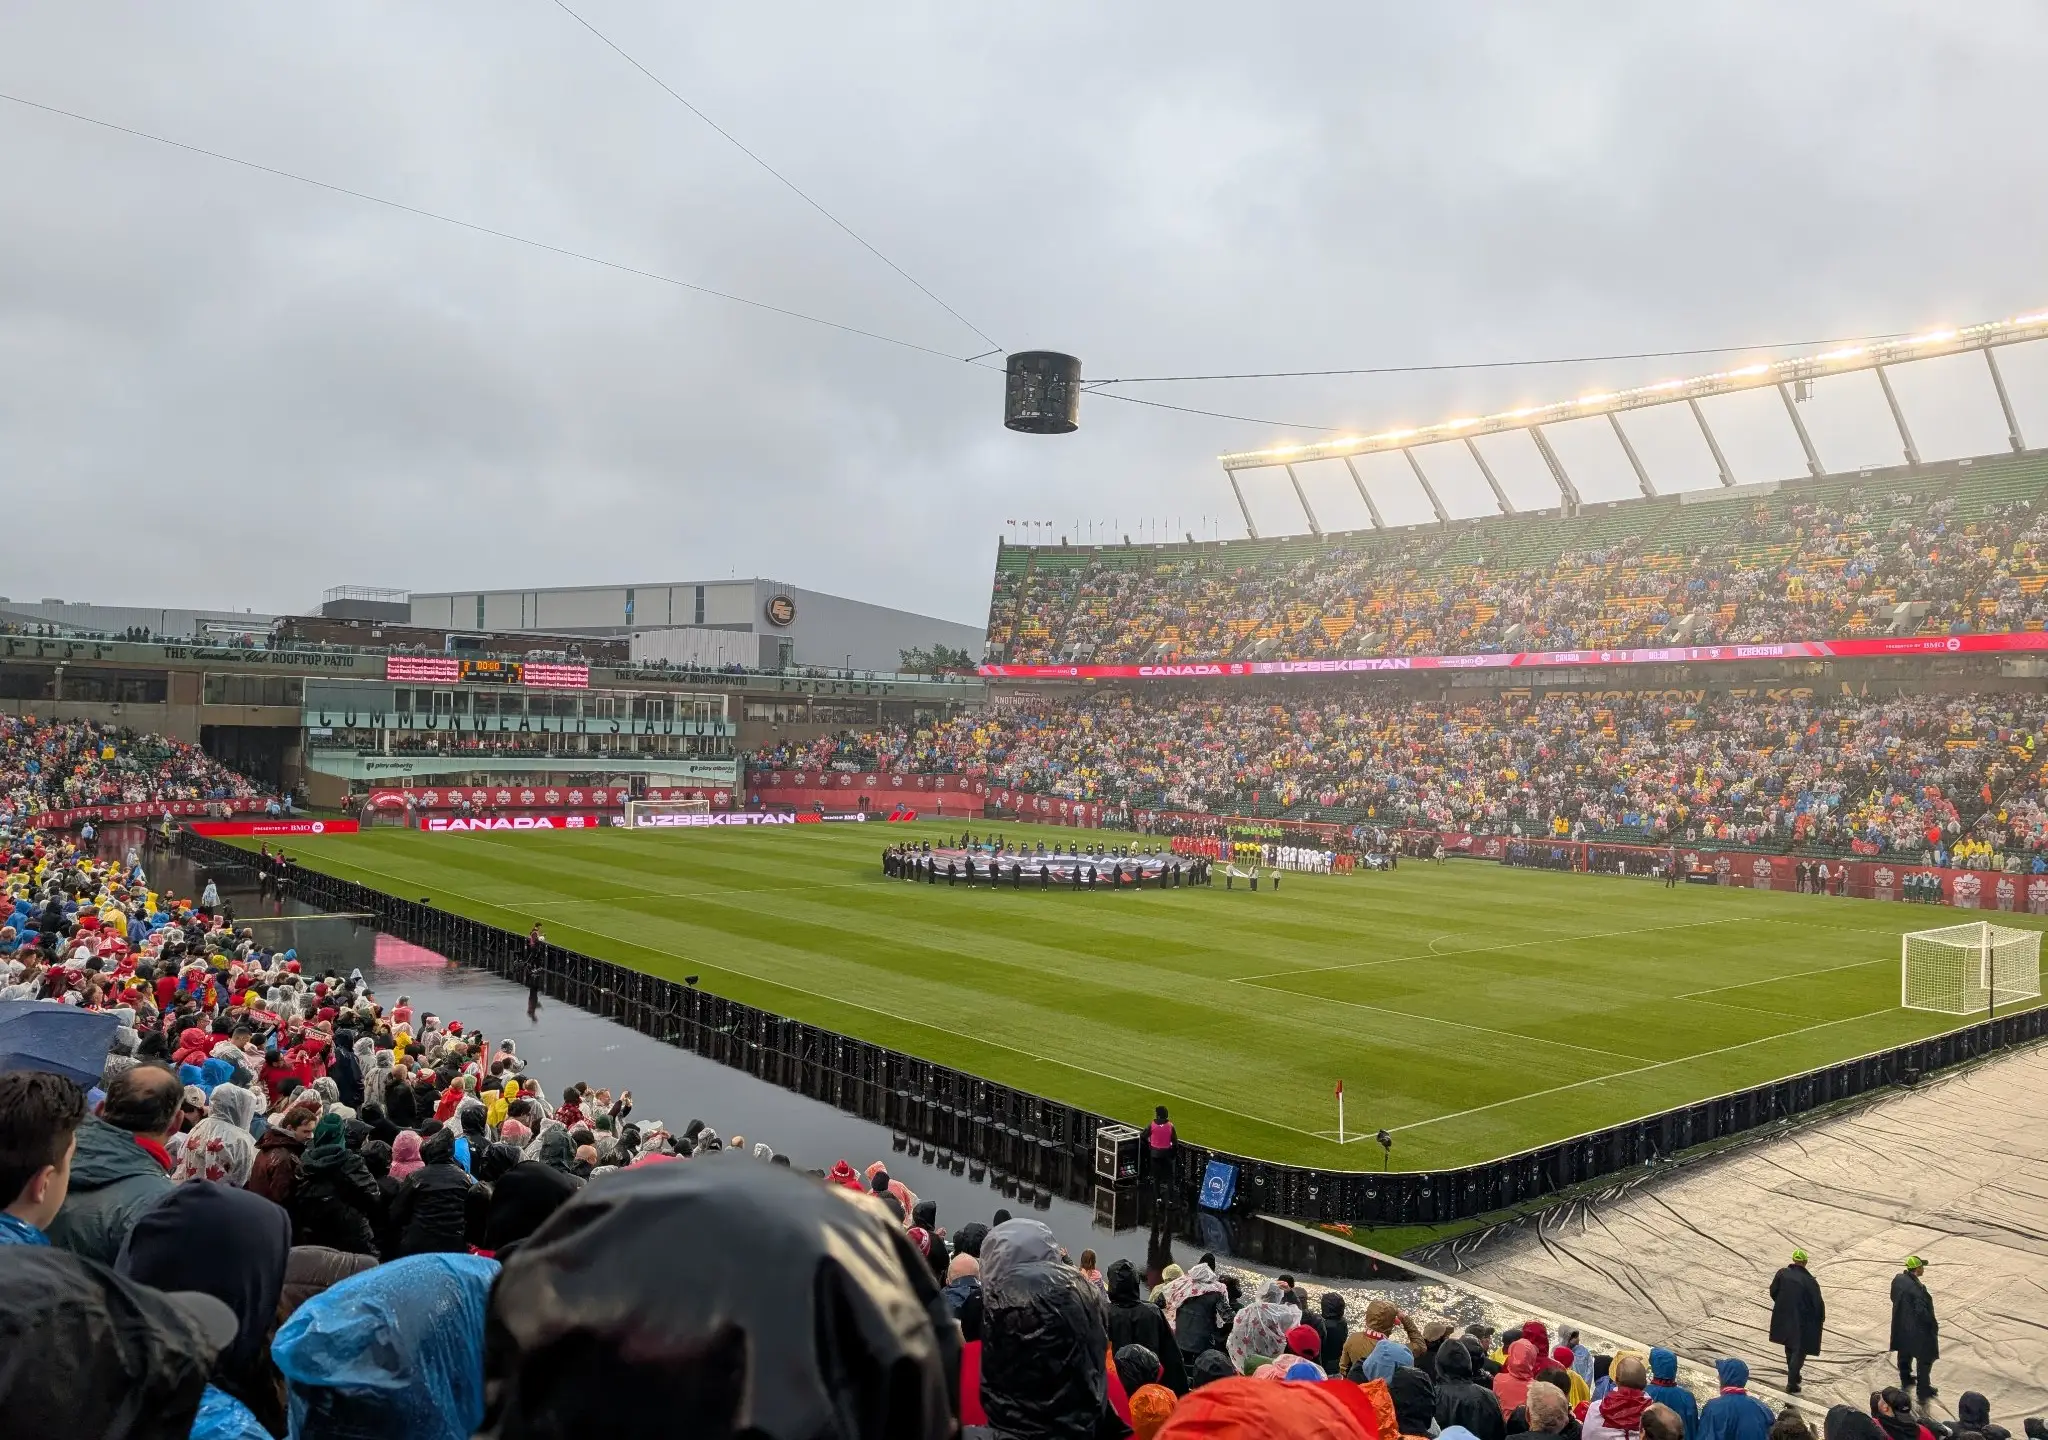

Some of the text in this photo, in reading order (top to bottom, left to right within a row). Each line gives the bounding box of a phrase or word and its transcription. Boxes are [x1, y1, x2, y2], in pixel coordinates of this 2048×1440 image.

[1923, 641, 1945, 649] BMO
[164, 646, 187, 659] THE
[243, 649, 270, 663] Club
[272, 652, 321, 665] ROOFTOP
[324, 654, 354, 667] PATIO
[1737, 646, 1783, 657] UZBEKISTAN
[1555, 653, 1580, 662] CANADA
[477, 661, 500, 671] 00:00
[1138, 664, 1223, 676] CANADA
[1281, 658, 1411, 673] UZBEKISTAN
[615, 670, 630, 680] THE
[690, 674, 726, 685] ROOFTOP
[726, 676, 747, 686] PATIO
[375, 762, 390, 770] play
[428, 817, 554, 831] CANADA
[637, 813, 796, 827] UZBEKISTAN
[290, 824, 311, 832] BMO
[1953, 880, 1981, 889] CANADA
